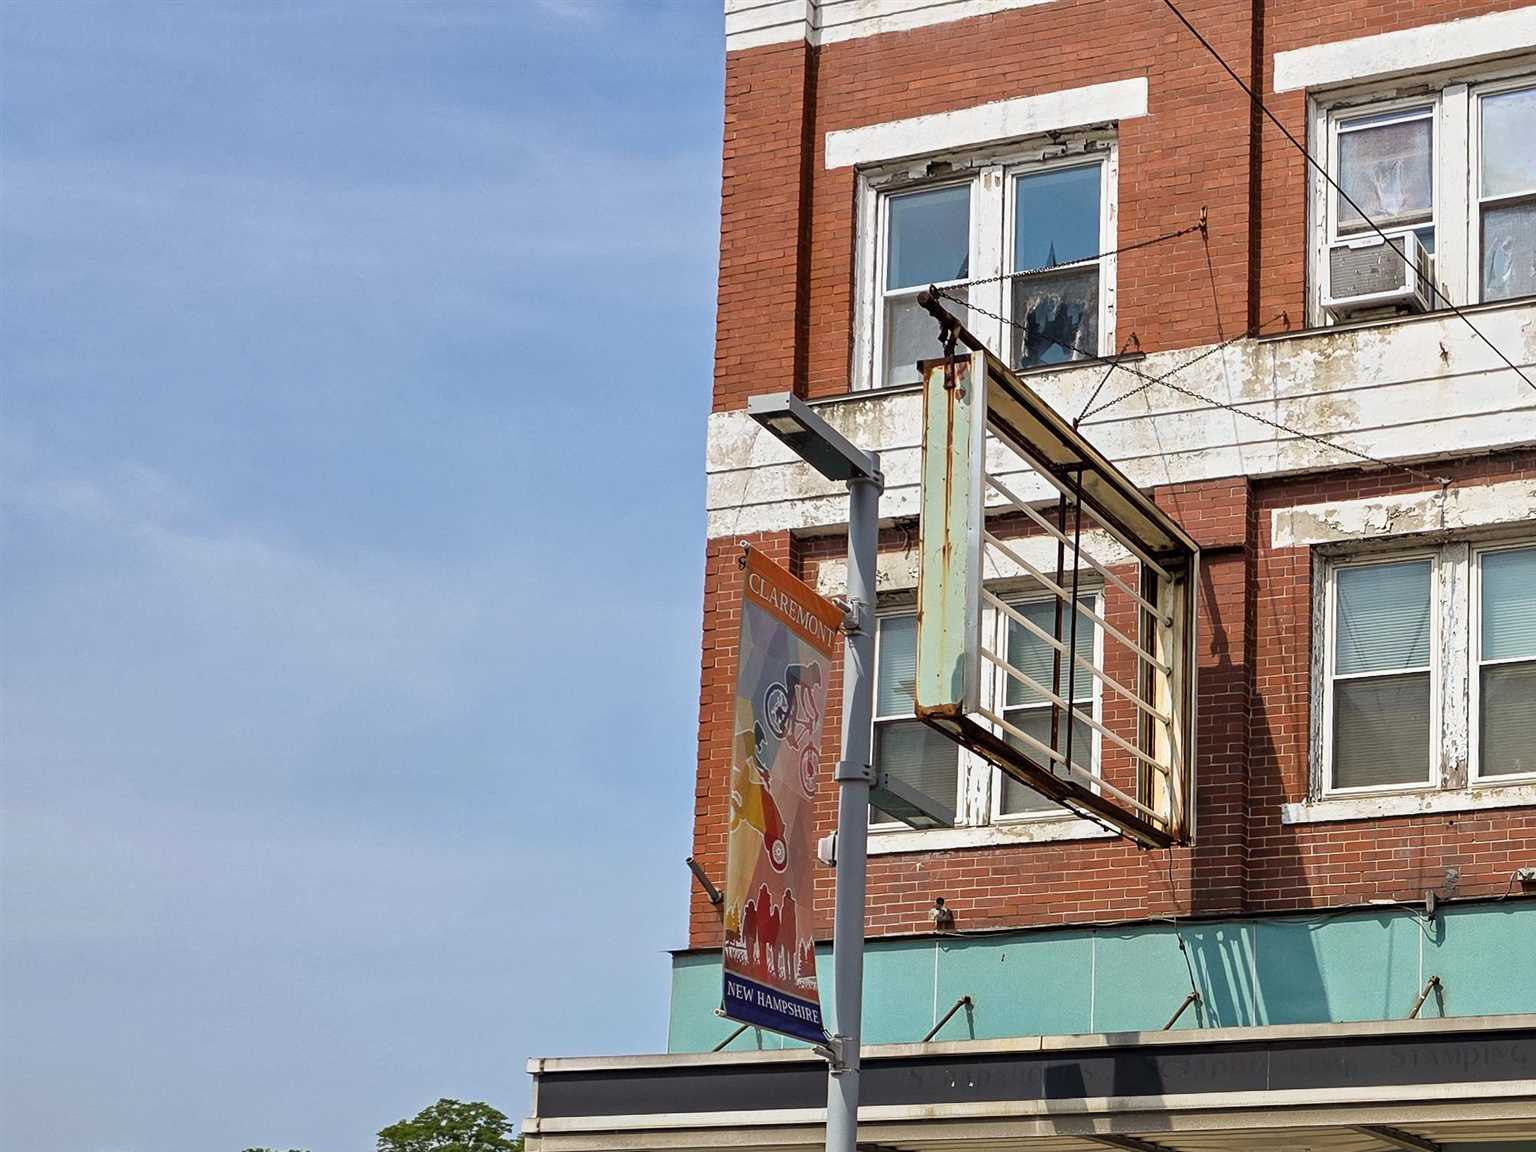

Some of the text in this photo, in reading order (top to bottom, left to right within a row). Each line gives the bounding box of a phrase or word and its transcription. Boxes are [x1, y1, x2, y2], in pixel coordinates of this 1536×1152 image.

[749, 573, 835, 648] CLAREMONT
[727, 981, 820, 1023] NEW HAMPSHIRE
